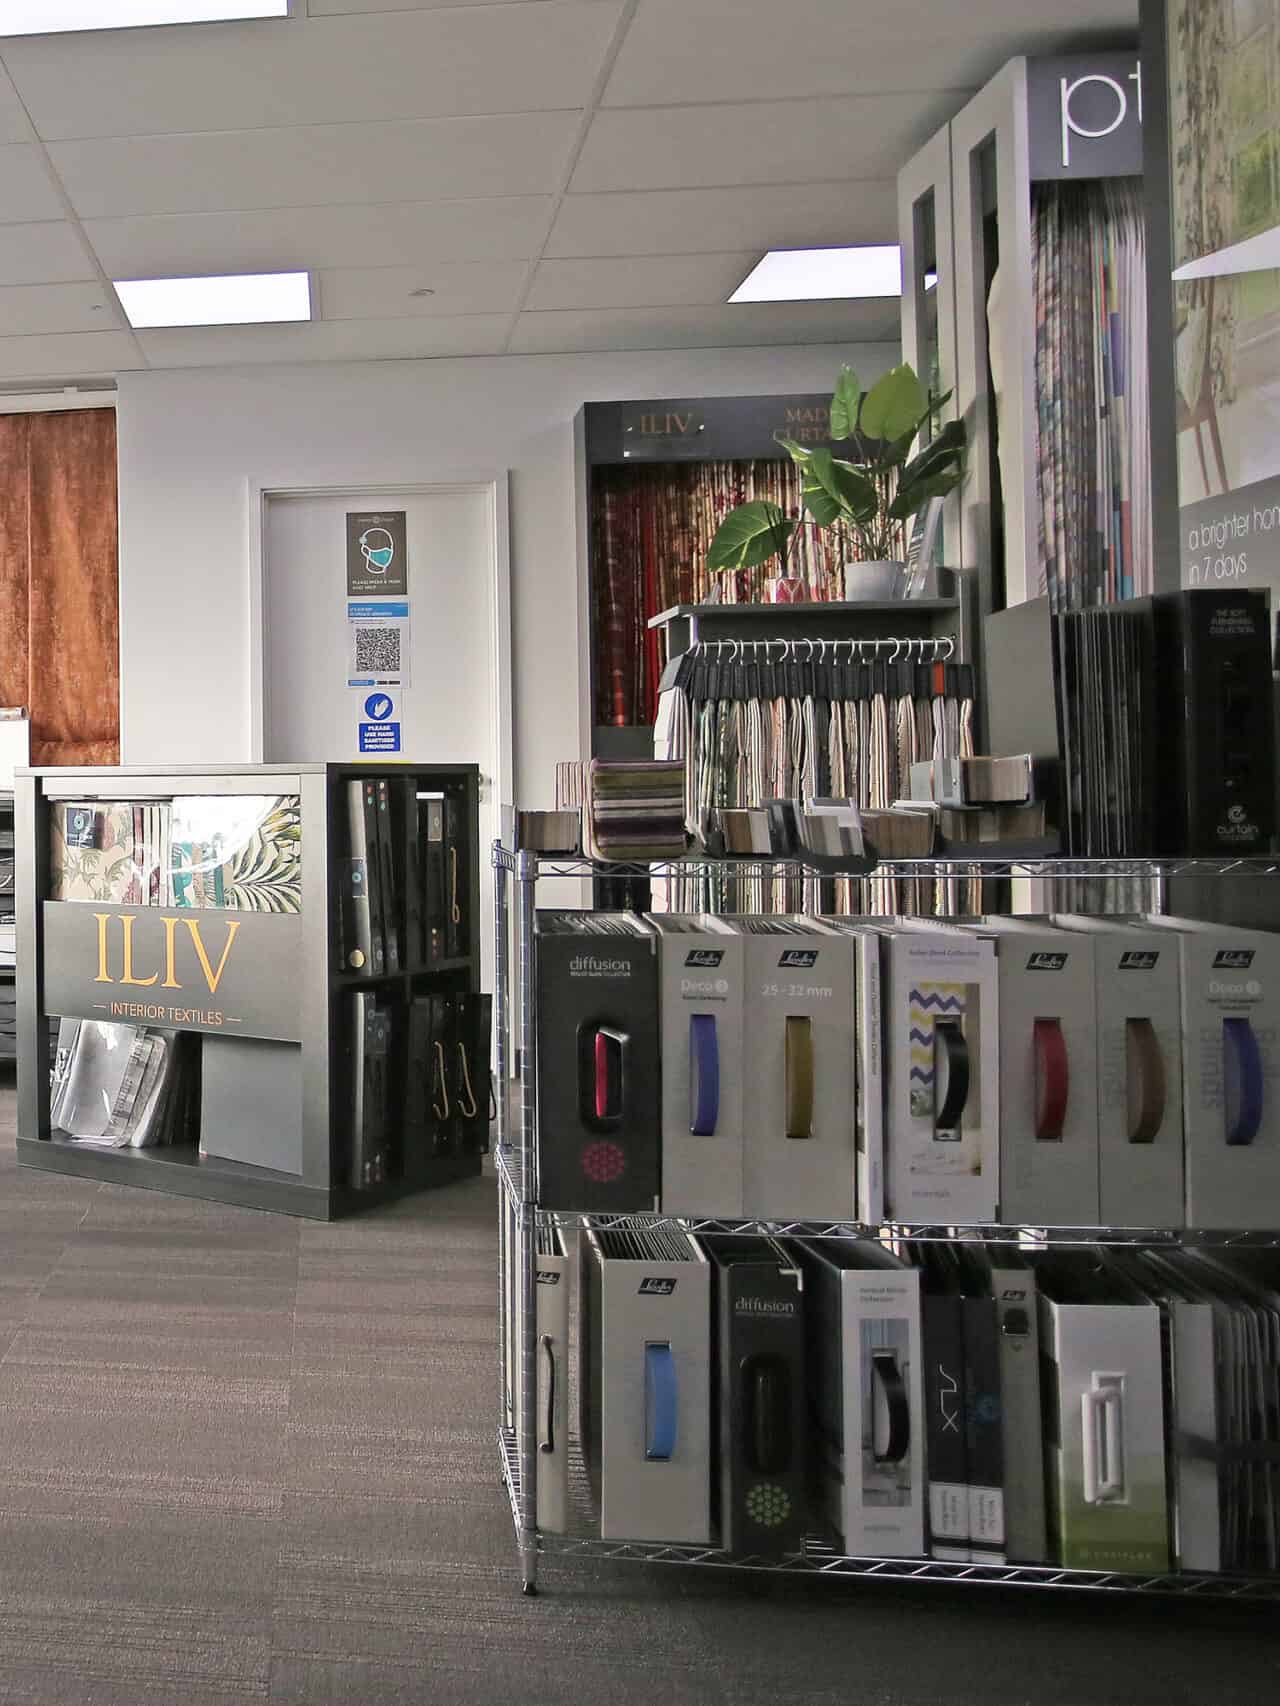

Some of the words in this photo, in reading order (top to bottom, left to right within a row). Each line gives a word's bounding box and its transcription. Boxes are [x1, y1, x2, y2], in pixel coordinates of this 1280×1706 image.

[639, 412, 694, 435] ILIV
[784, 406, 833, 423] MAD
[1188, 529, 1200, 552] a
[1200, 511, 1249, 551] brighter
[1202, 555, 1213, 582] 7
[1214, 552, 1249, 581] days
[93, 913, 241, 993] ILIV
[569, 955, 631, 970] diffusion
[111, 1001, 166, 1020] INTERIOR
[169, 1007, 224, 1026] TEXTILES
[735, 1296, 794, 1312] diffusion
